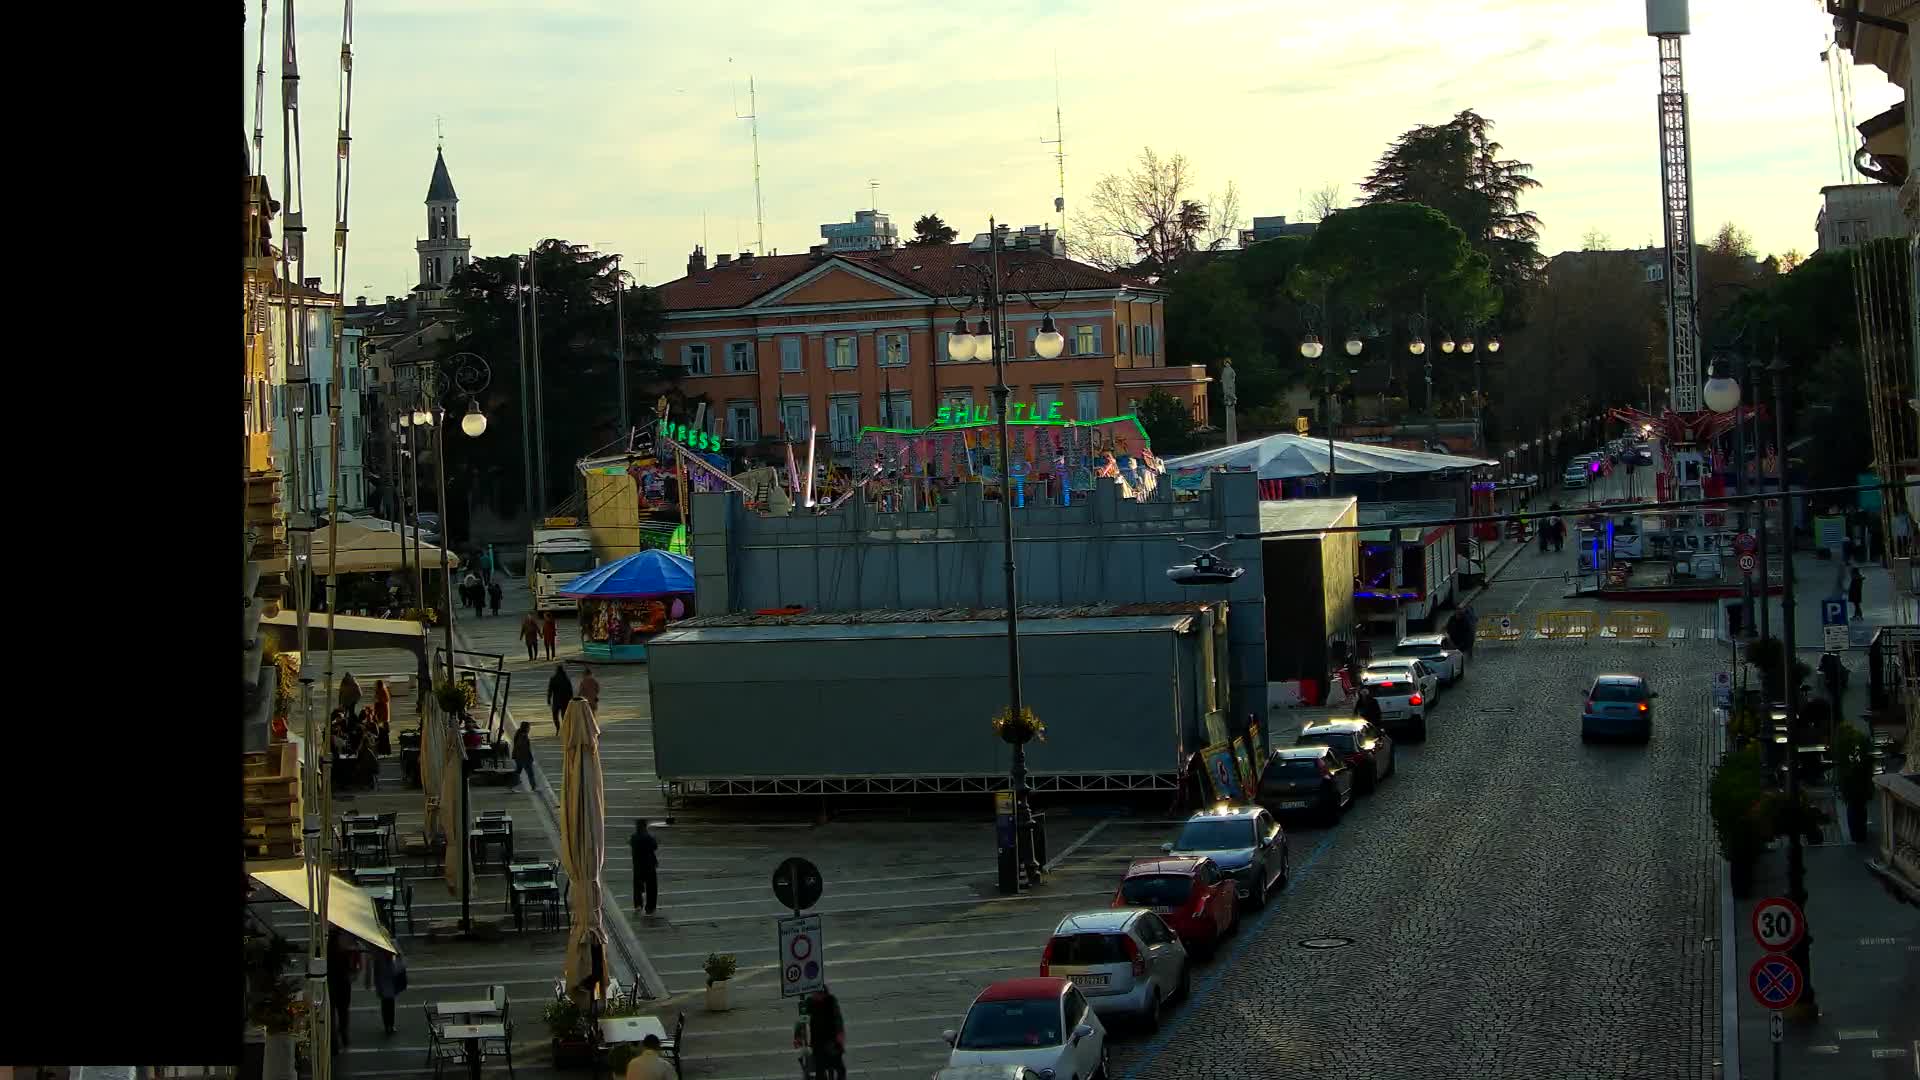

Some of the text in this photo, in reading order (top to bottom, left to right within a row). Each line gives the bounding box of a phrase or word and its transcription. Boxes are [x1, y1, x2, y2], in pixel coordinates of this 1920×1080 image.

[936, 401, 1064, 424] SHUTLE
[1827, 602, 1842, 622] P
[1762, 911, 1791, 938] 30
